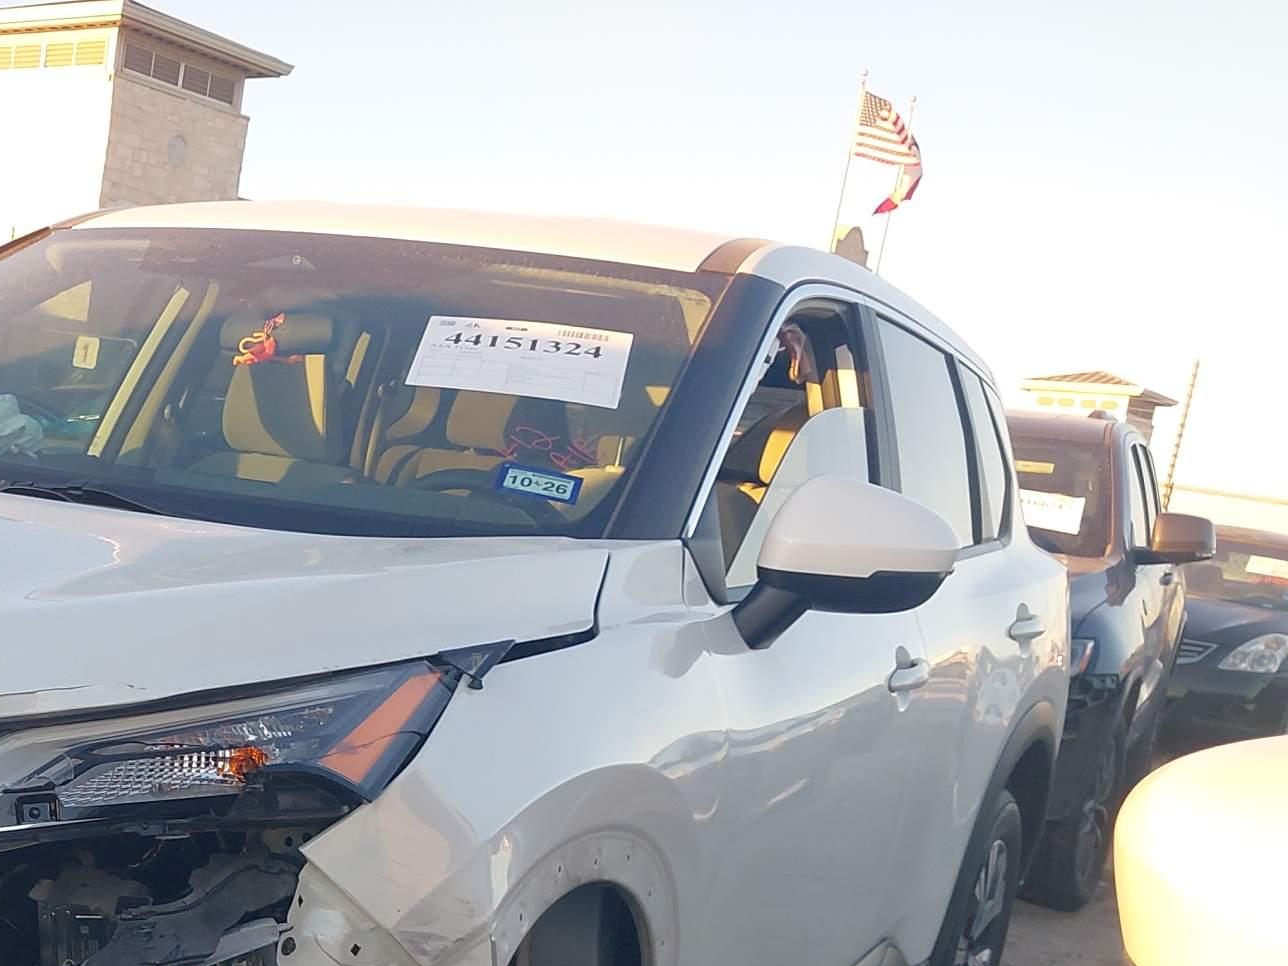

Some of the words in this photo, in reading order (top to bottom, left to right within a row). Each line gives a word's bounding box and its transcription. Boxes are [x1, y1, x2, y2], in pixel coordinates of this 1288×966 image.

[444, 331, 604, 359] 44151324
[508, 474, 533, 488] 10
[542, 481, 569, 495] 26
